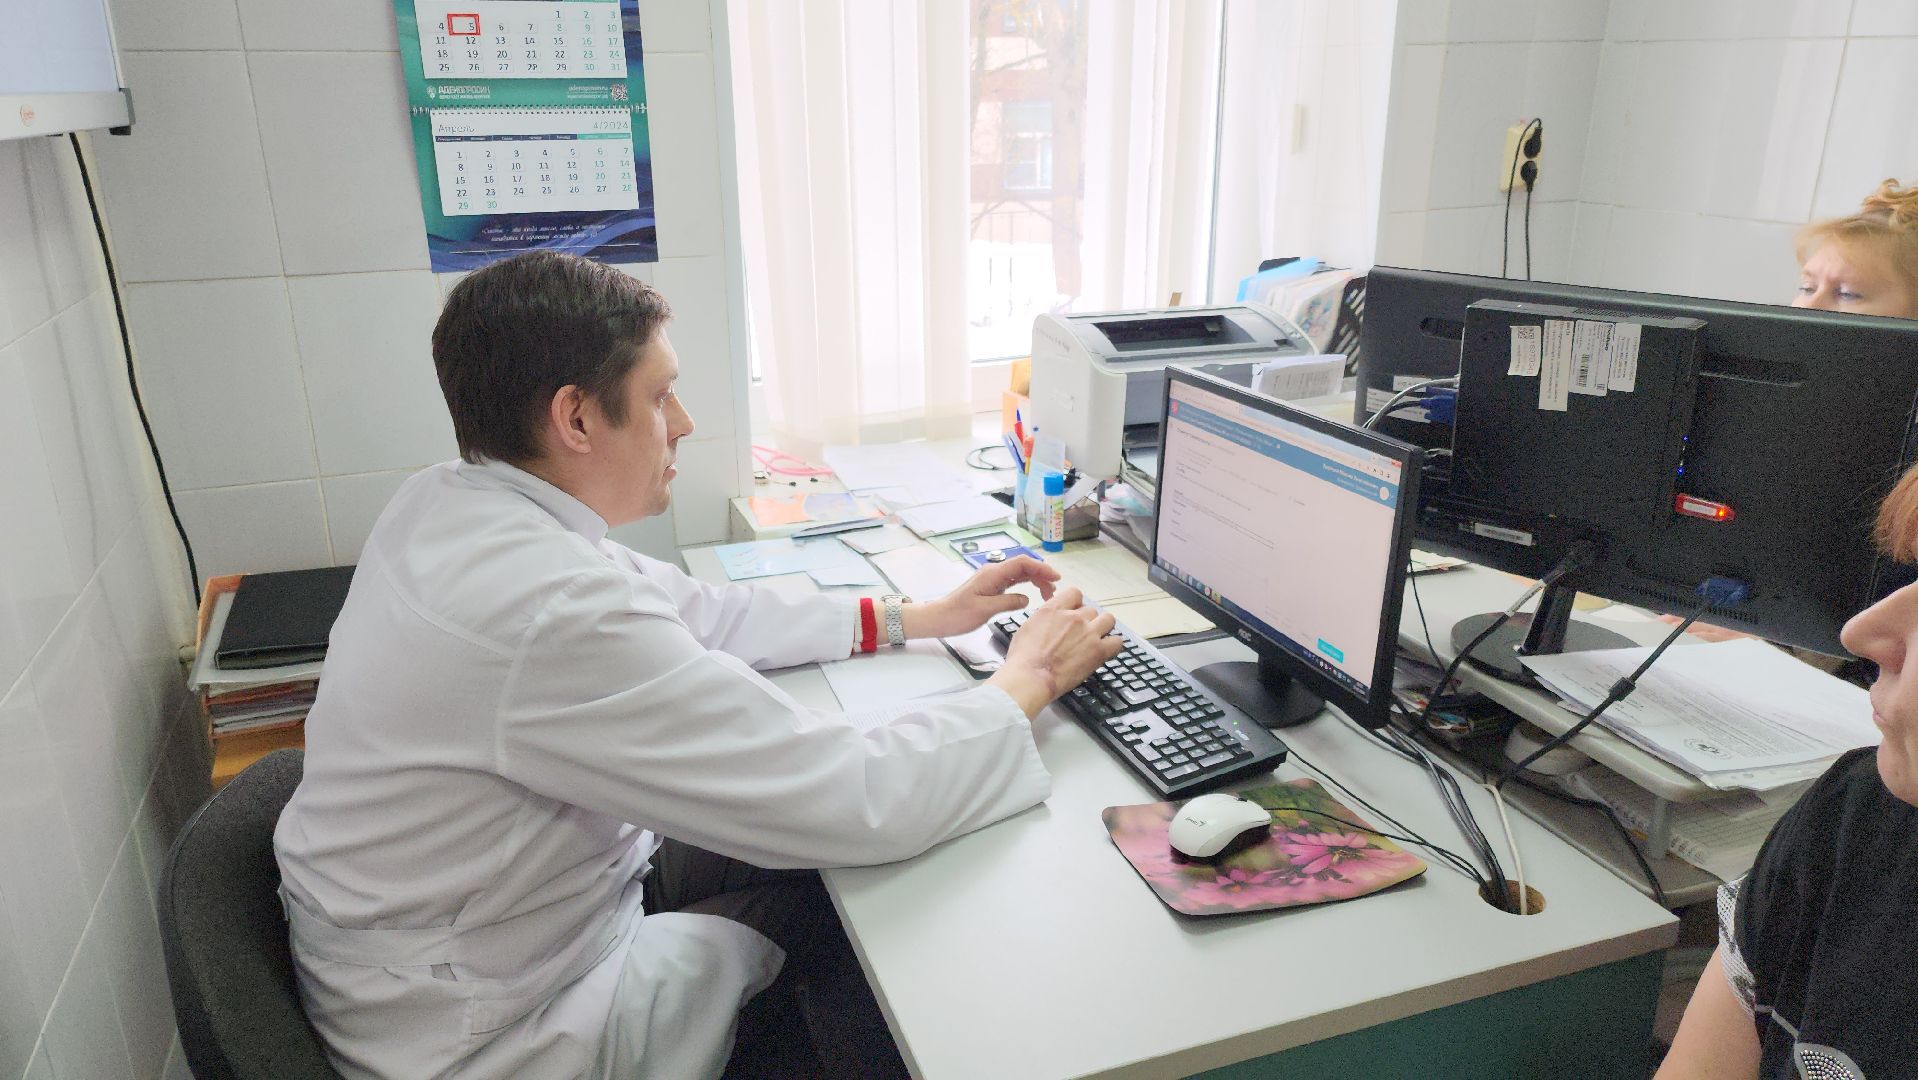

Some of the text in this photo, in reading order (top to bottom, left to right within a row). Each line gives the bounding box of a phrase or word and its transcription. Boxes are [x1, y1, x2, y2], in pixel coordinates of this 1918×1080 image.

[556, 10, 616, 19] 1 2 3
[469, 22, 475, 31] 5
[556, 23, 562, 32] 8
[584, 23, 591, 32] 9
[607, 24, 617, 32] 10
[436, 36, 445, 44] 11
[466, 36, 476, 45] 12
[496, 36, 506, 44] 13
[582, 37, 592, 46] 16
[608, 37, 618, 46] 17
[437, 49, 620, 59] 18 19 20 21 22 23 24
[439, 124, 474, 133] Апрель
[597, 147, 603, 156] 6
[458, 163, 464, 172] 8
[484, 176, 494, 184] 16
[596, 172, 606, 180] 20
[458, 200, 498, 210] 29 30
[1238, 628, 1251, 641] AOC
